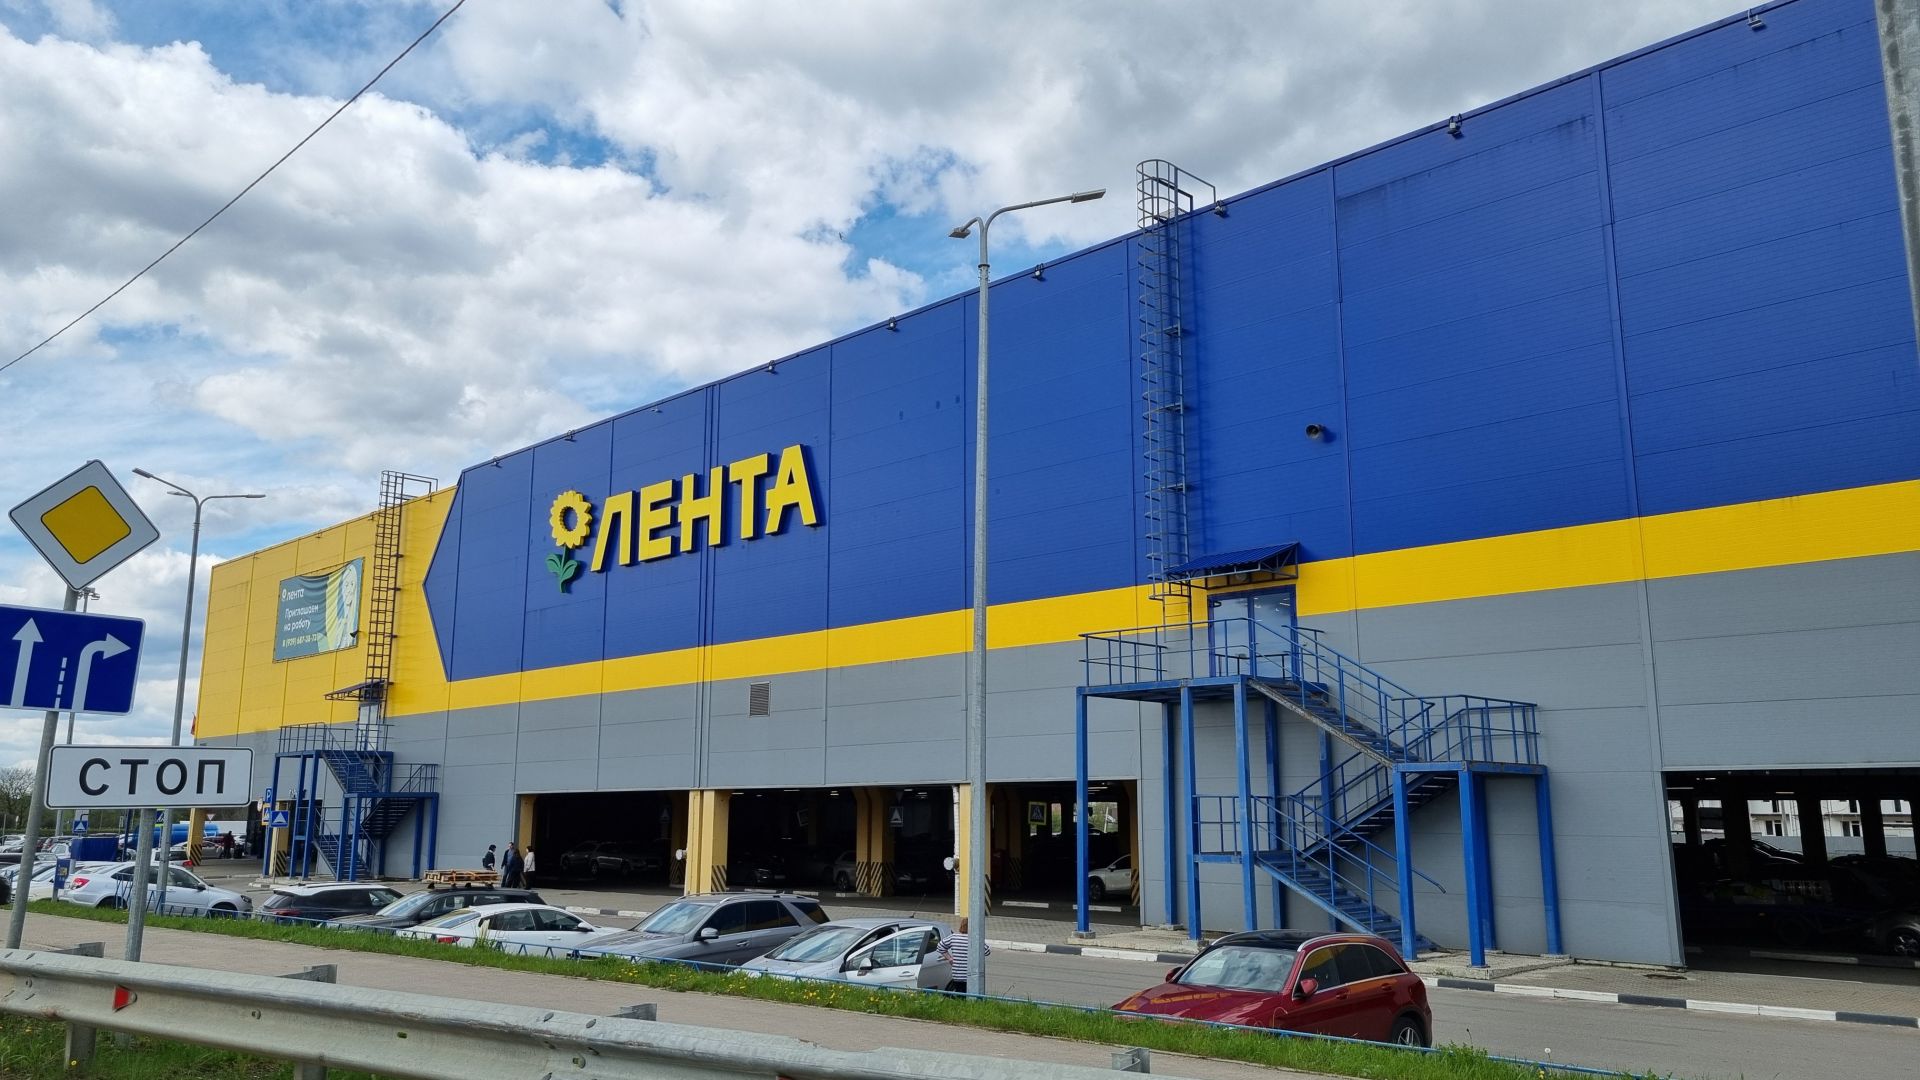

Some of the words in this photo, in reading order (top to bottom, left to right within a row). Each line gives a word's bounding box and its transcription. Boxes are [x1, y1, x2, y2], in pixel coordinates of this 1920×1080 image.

[590, 444, 818, 572] ЛЕНТА
[286, 588, 304, 600] лента
[285, 604, 318, 620] Приглашаем
[292, 618, 311, 632] работу
[78, 757, 226, 796] СТОП
